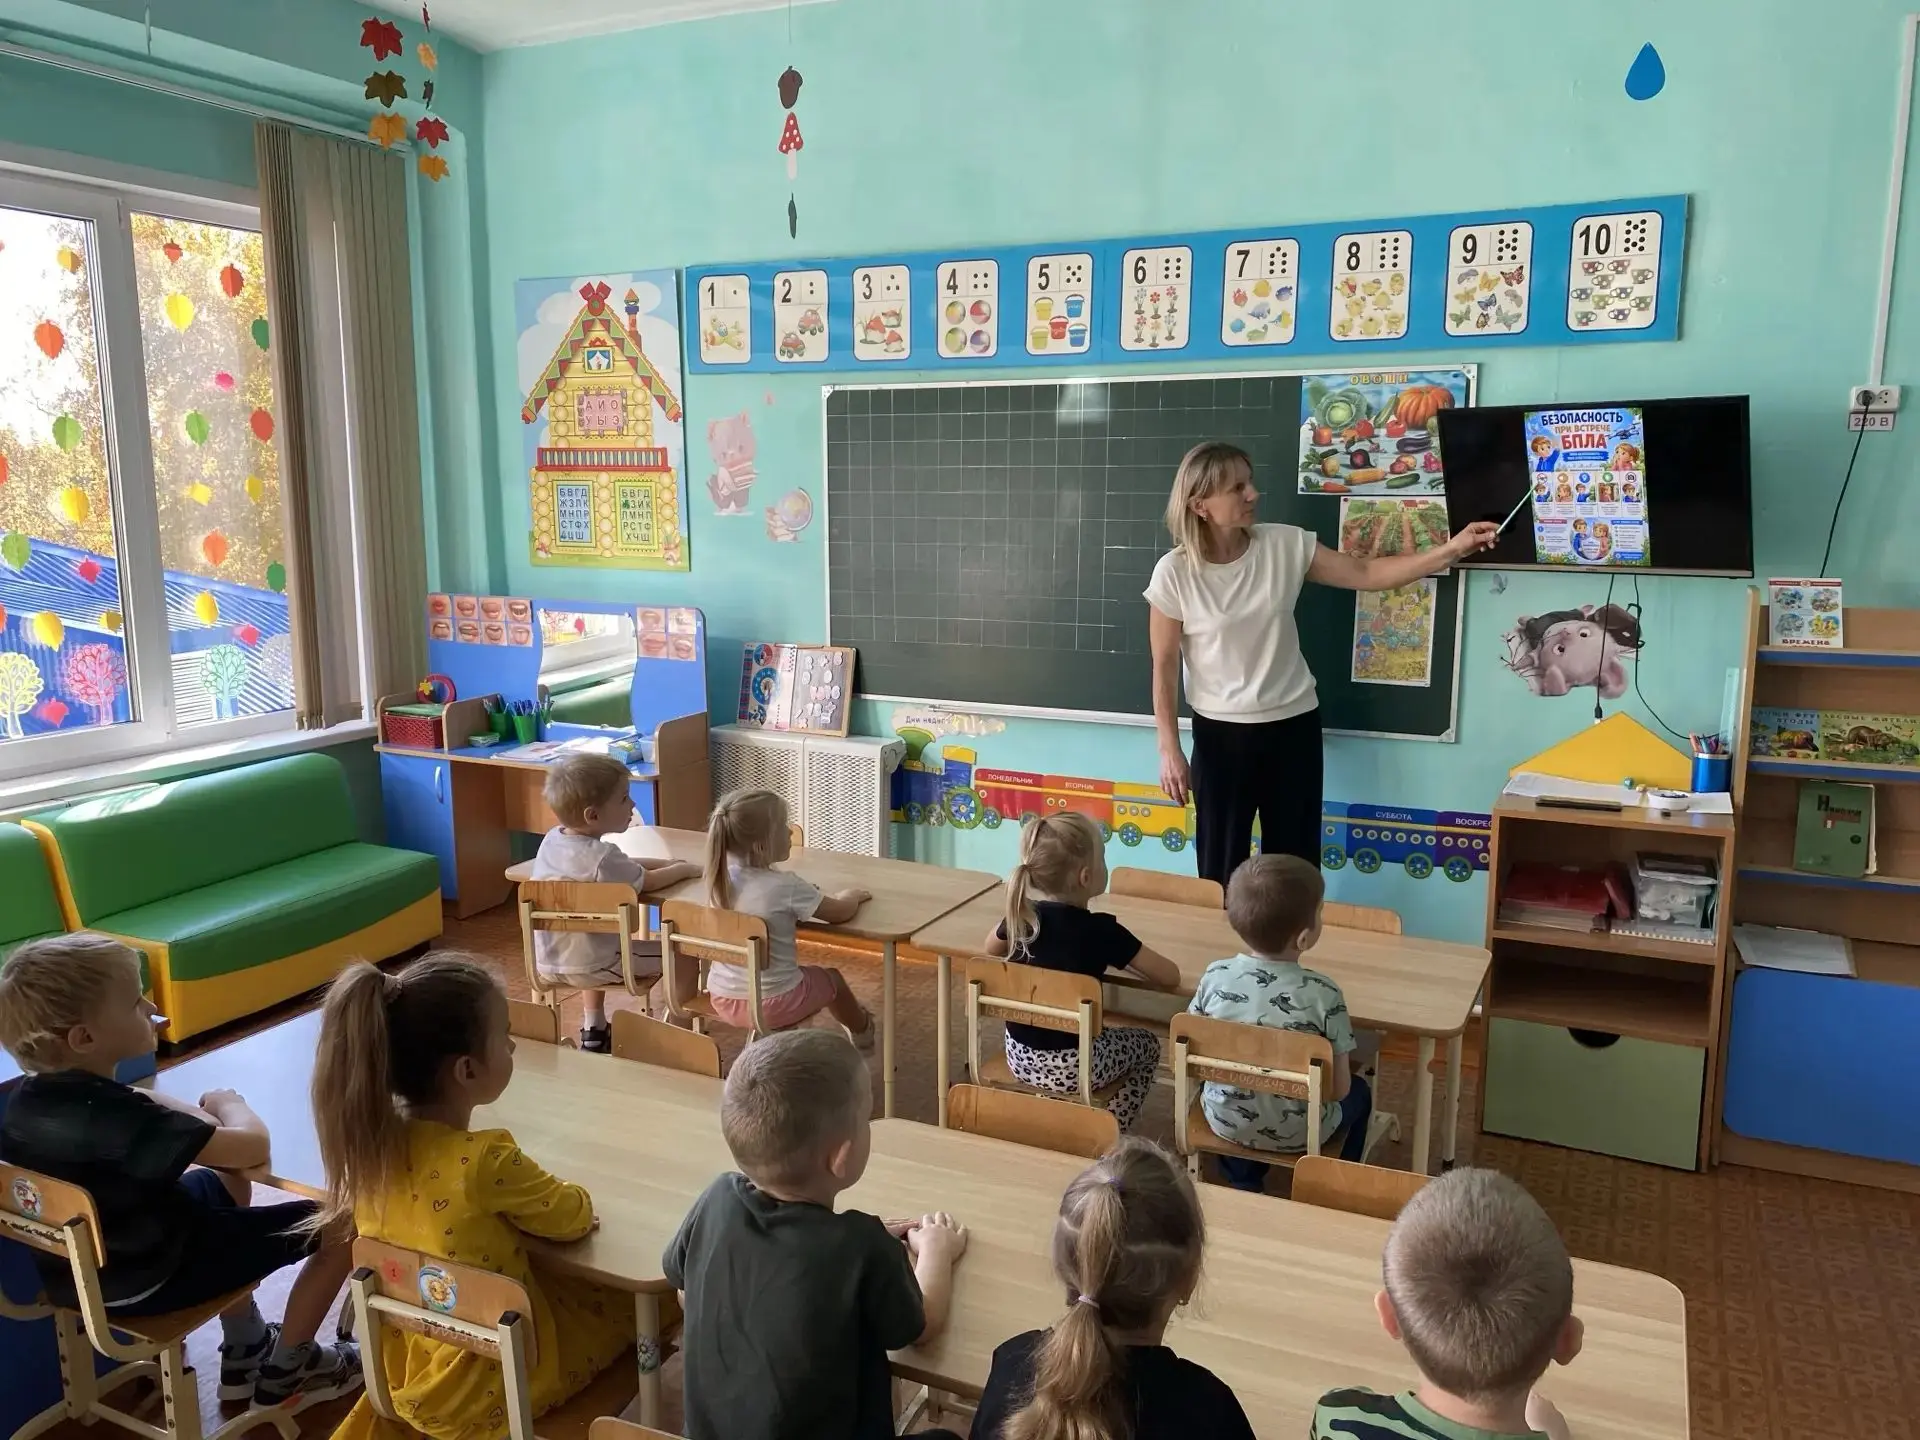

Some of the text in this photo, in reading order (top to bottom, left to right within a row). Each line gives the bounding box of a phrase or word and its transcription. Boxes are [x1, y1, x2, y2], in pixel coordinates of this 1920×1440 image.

[708, 223, 1611, 307] 1 2 3 4 5 6 7 8 9 10
[1541, 411, 1623, 426] БЕЗОПАСНОСТЬ
[1854, 416, 1876, 427] 220
[1555, 424, 1611, 434] ПРИ ВСТРЕЧЕ
[1561, 433, 1608, 450] БПЛА
[988, 773, 1034, 786] ПОНЕДЕЛЬНИК
[1065, 781, 1095, 791] ВТОРНИК
[1375, 811, 1413, 821] СУББОТА
